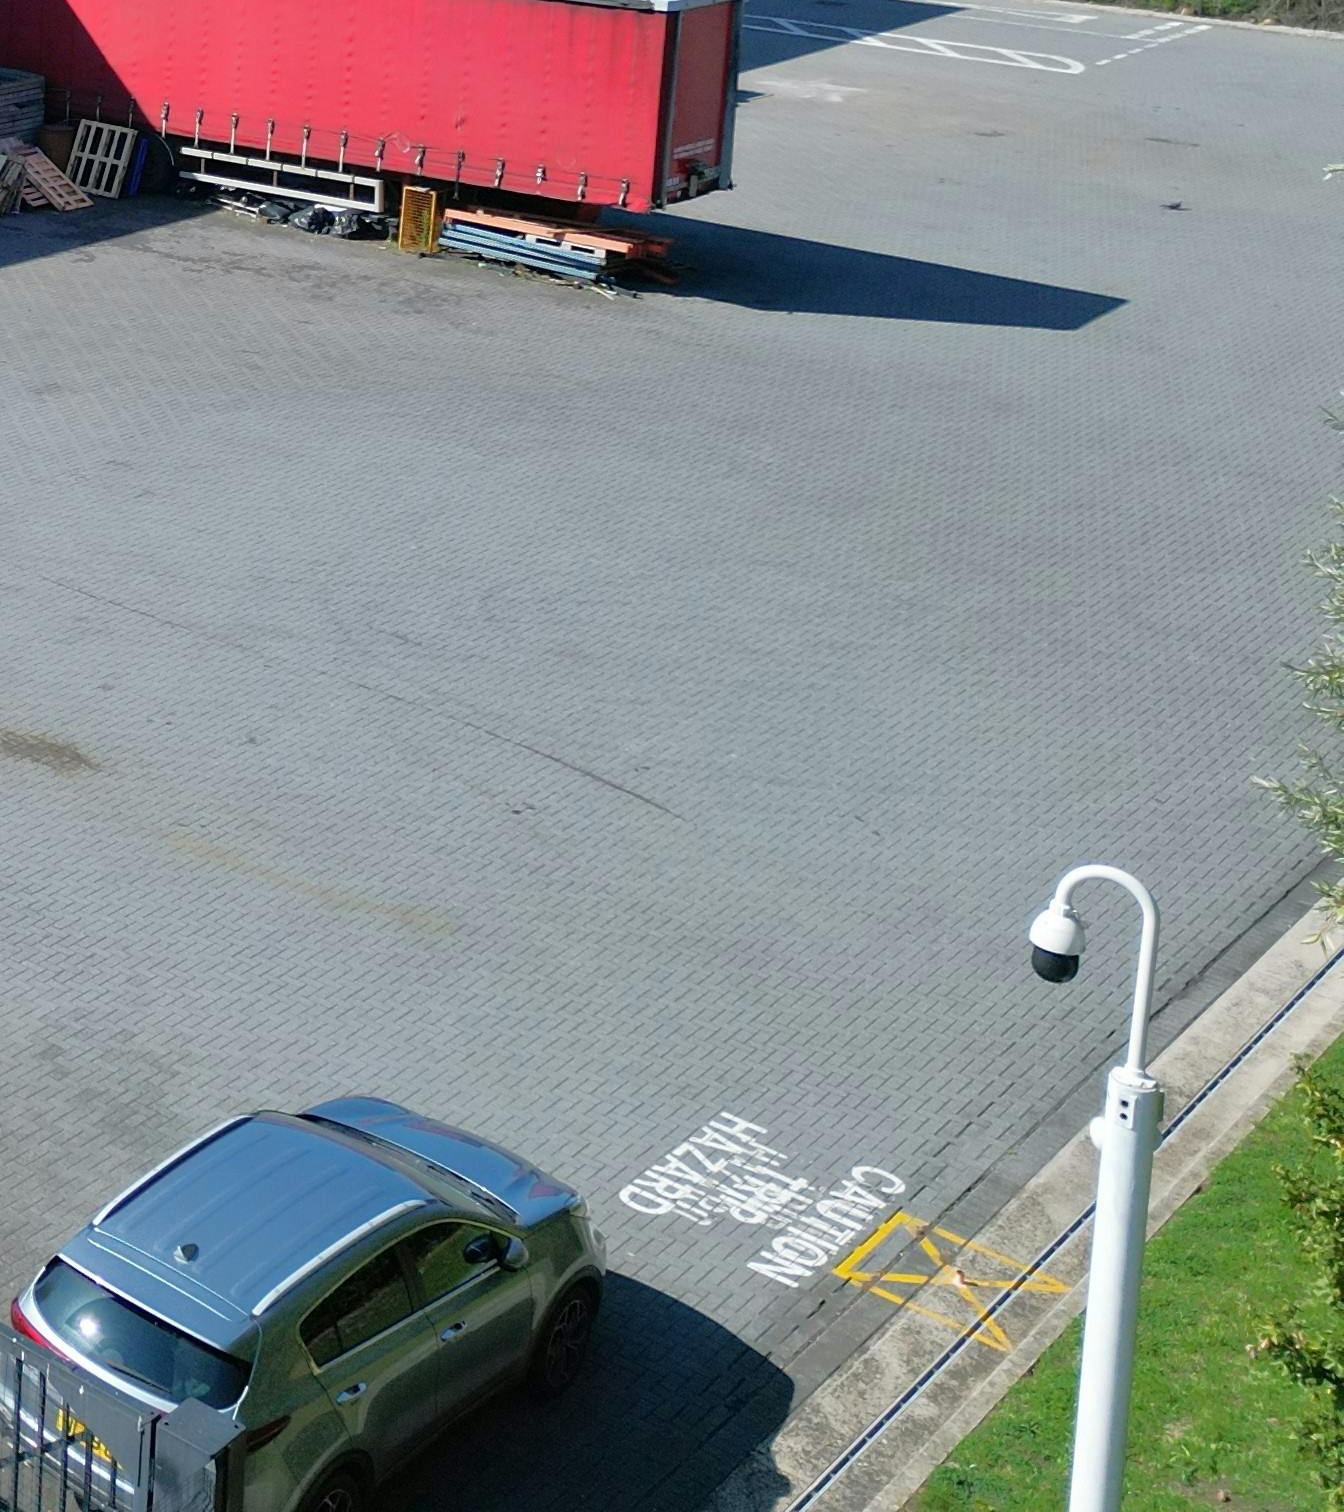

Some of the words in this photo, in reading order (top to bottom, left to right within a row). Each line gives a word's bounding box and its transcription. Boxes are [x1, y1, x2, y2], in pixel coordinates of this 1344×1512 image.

[618, 1110, 768, 1216] HAZARD
[713, 1161, 812, 1225] TRIP
[746, 1164, 906, 1289] CAUTION
